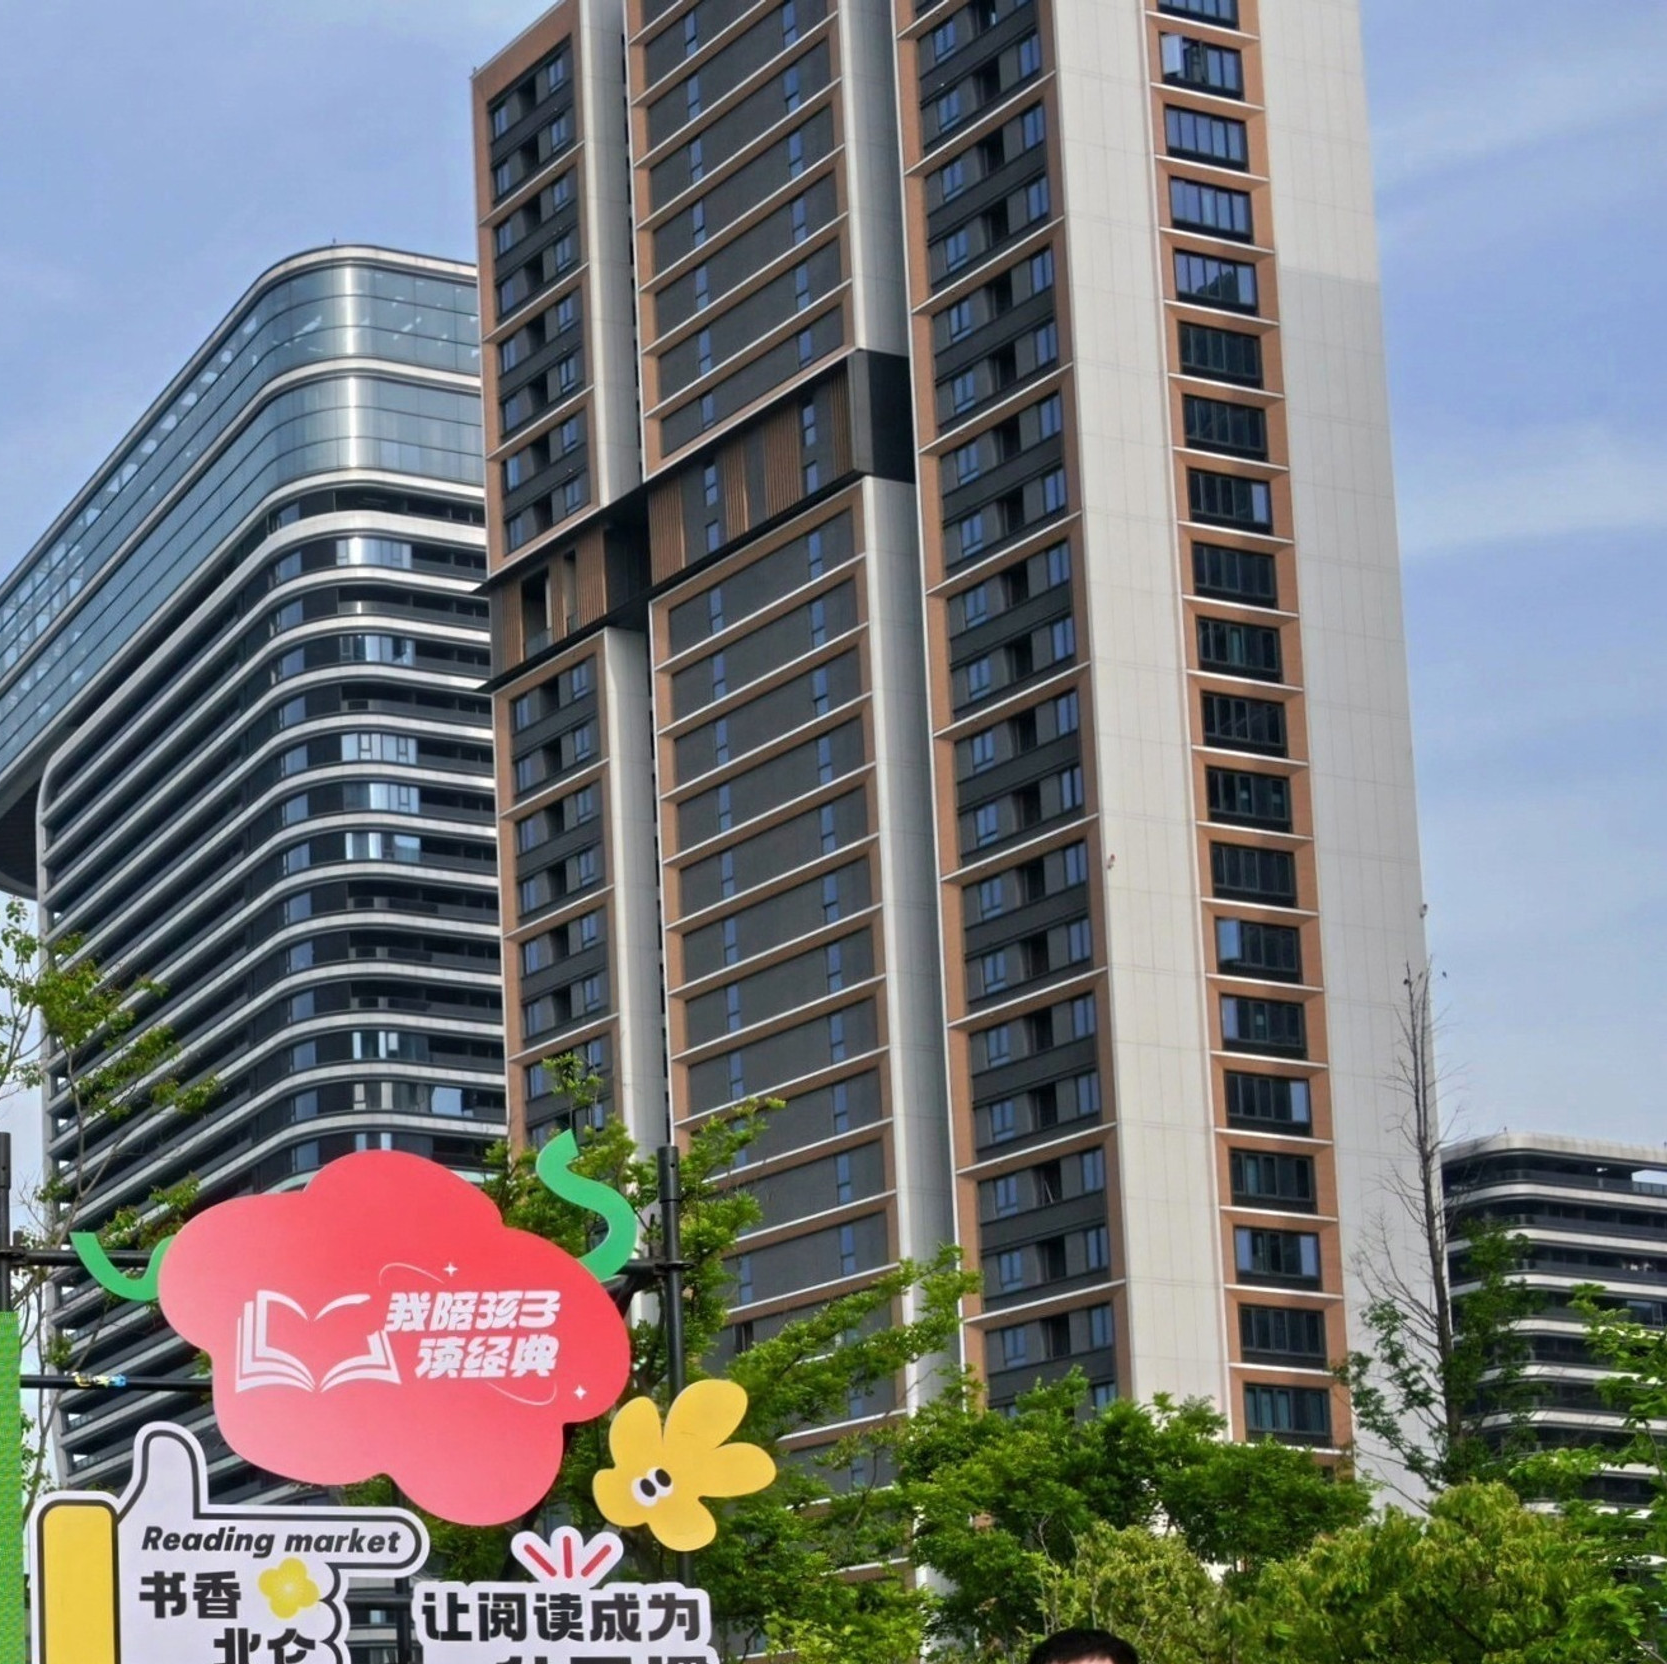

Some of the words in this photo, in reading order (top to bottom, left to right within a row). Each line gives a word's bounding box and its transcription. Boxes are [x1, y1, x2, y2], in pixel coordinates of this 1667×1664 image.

[385, 1289, 562, 1333] 我陪孩子
[413, 1336, 560, 1380] 读经典
[141, 1527, 275, 1558] Reading
[284, 1529, 400, 1554] market
[139, 1570, 241, 1620] 书香
[421, 1592, 701, 1642] 让阅读成为
